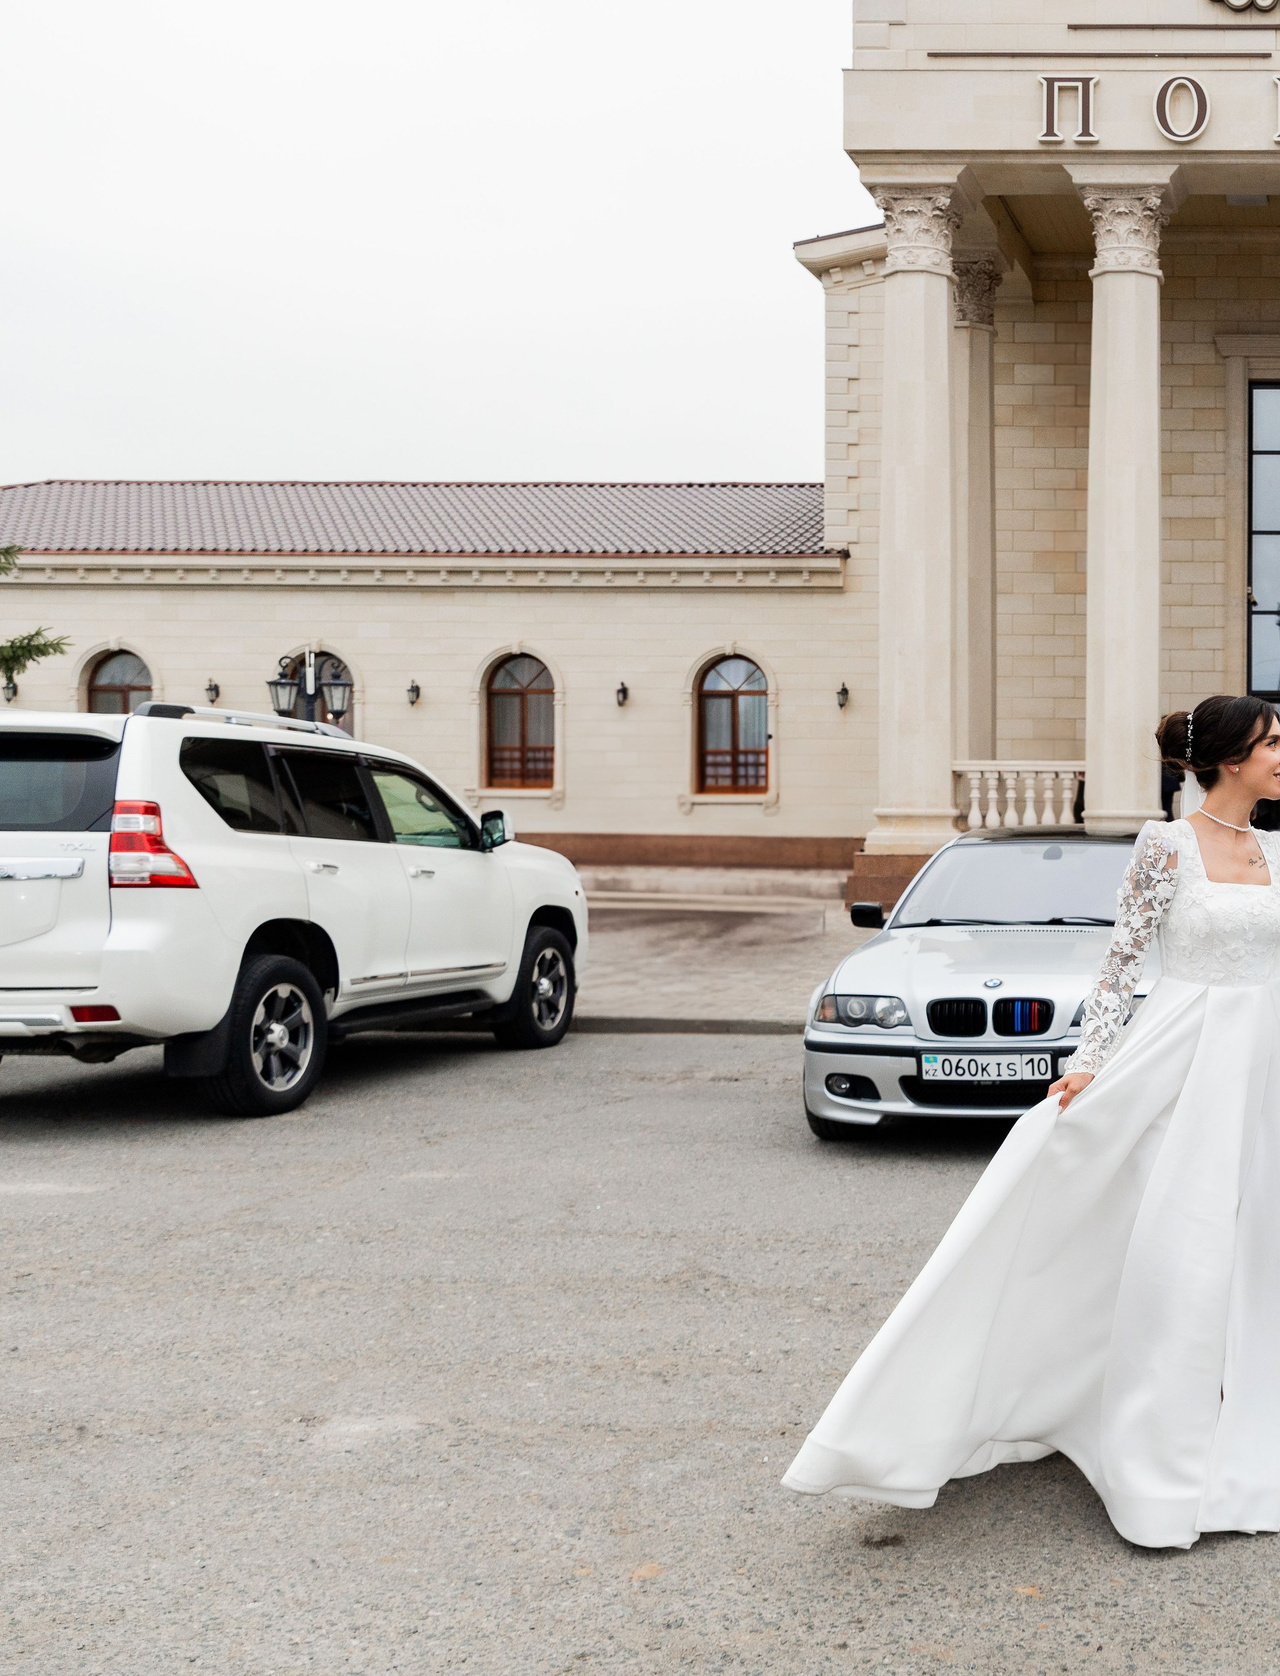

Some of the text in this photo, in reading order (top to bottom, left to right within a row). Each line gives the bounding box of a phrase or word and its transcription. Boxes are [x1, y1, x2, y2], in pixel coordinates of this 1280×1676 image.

[924, 1068, 938, 1077] KZ
[941, 1057, 1049, 1077] 060KIS 10
